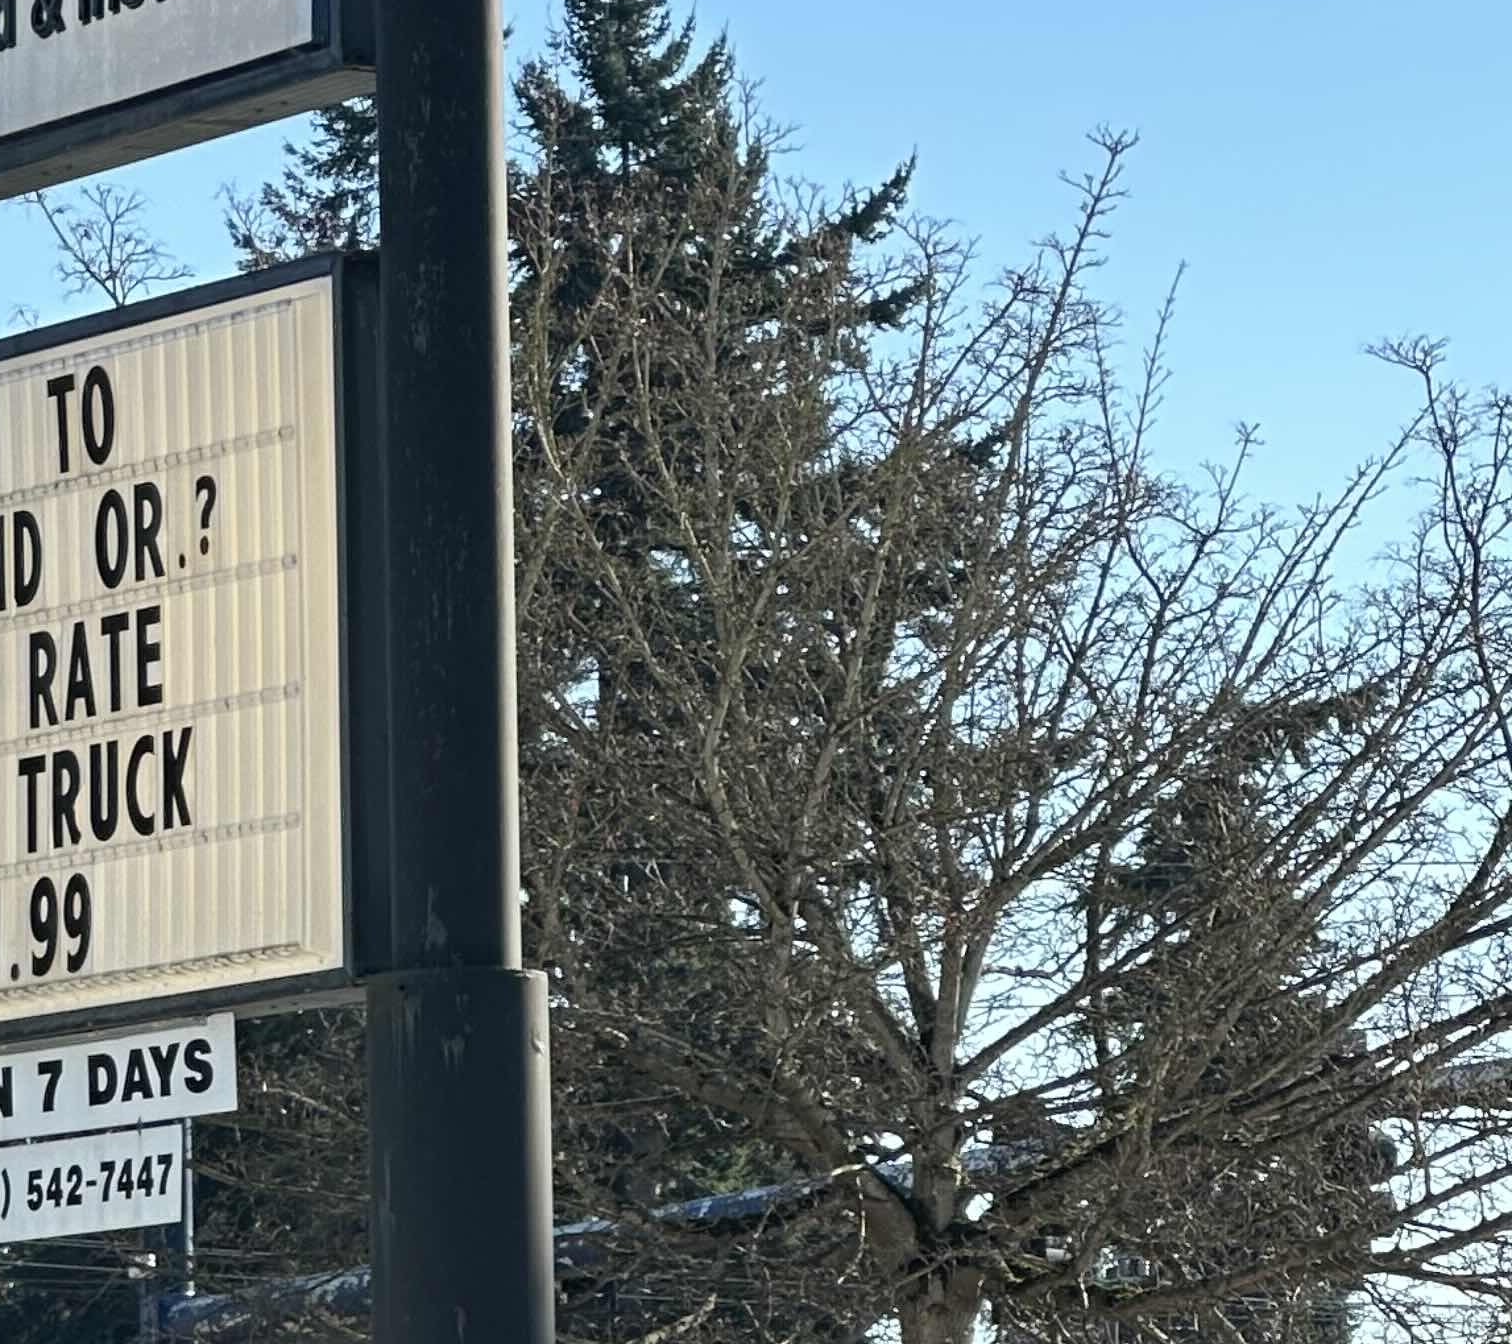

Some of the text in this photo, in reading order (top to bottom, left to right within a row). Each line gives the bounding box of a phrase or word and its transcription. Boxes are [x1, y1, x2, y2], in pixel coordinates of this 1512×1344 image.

[47, 365, 116, 473] TO
[29, 605, 163, 728] RATE
[18, 726, 193, 854] TRUCK
[38, 1059, 63, 1112] 7
[88, 1039, 214, 1107] DAYS
[27, 1154, 174, 1211] 542-7447
